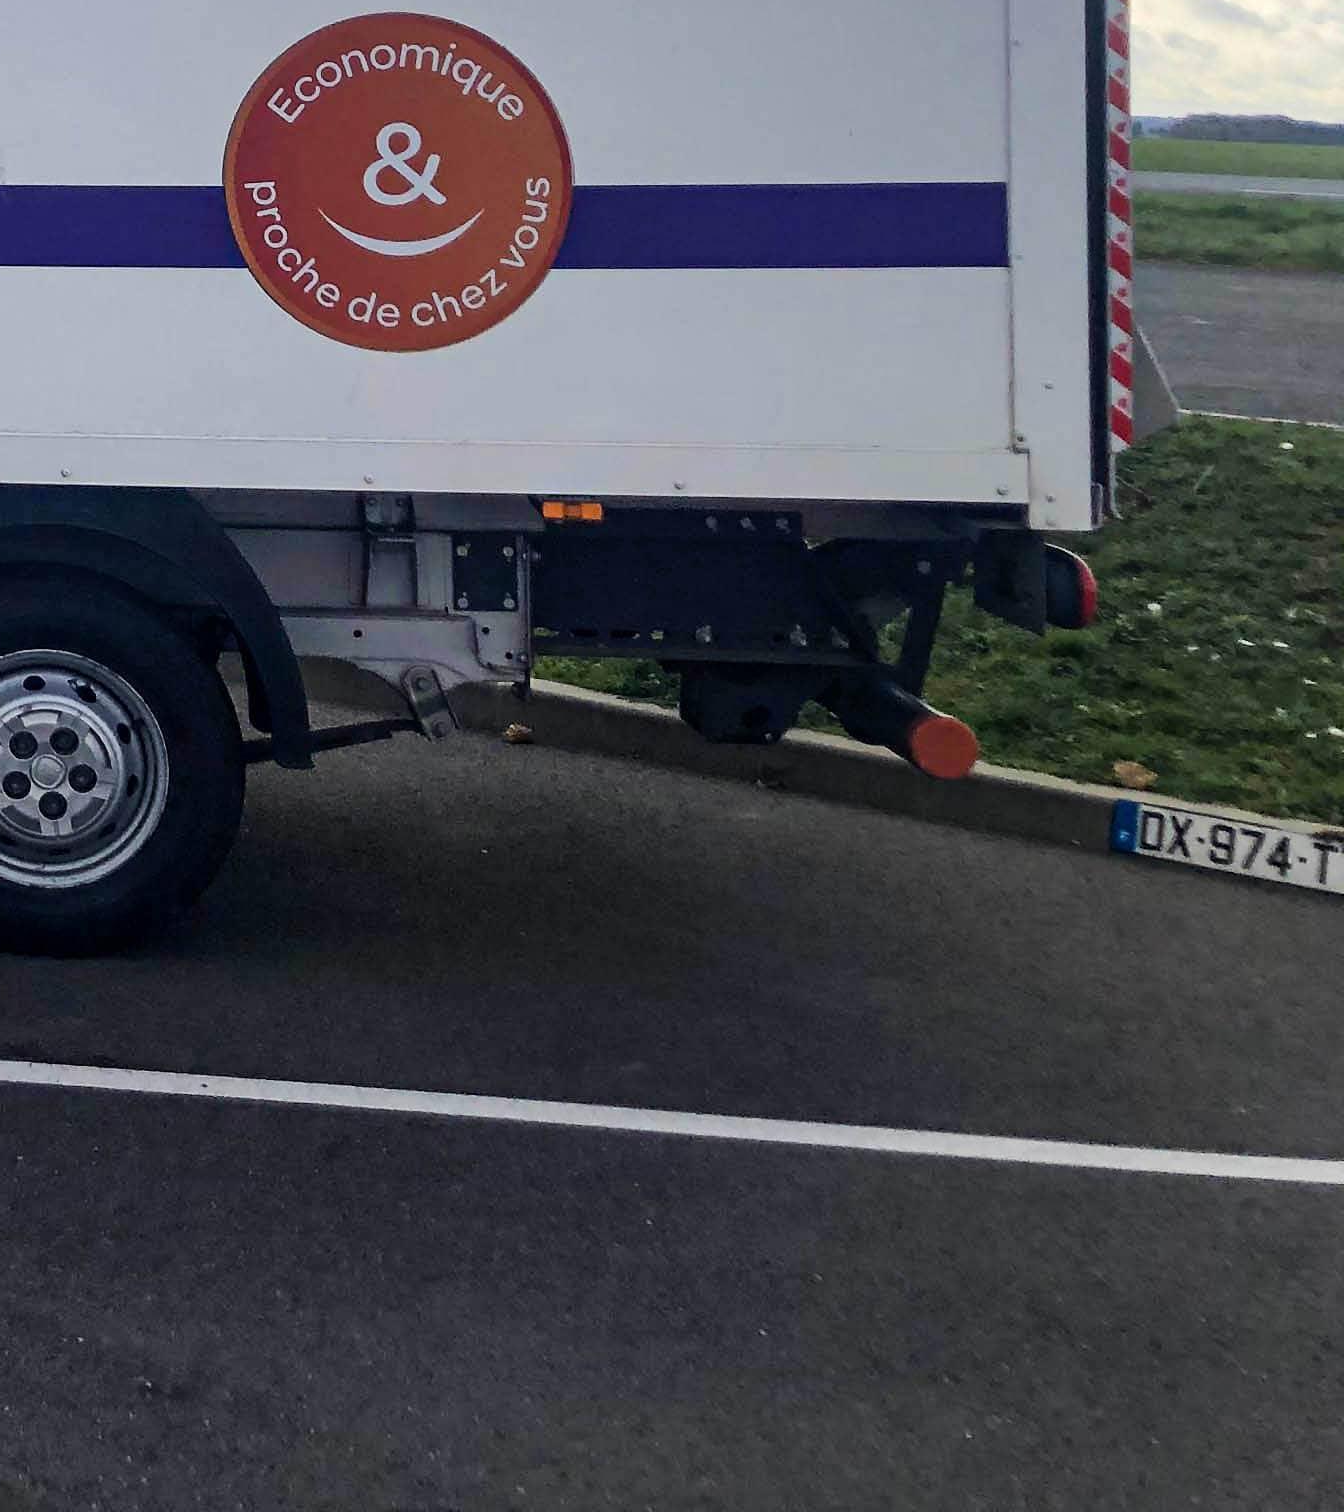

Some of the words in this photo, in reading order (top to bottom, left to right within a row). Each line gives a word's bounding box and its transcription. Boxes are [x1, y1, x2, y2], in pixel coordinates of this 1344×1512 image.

[267, 43, 524, 123] Economique
[363, 121, 447, 206] &
[244, 180, 341, 307] proche
[348, 292, 401, 327] de
[411, 269, 508, 327] chez
[500, 176, 551, 268] vous
[1139, 811, 1344, 885] DX-974-T
